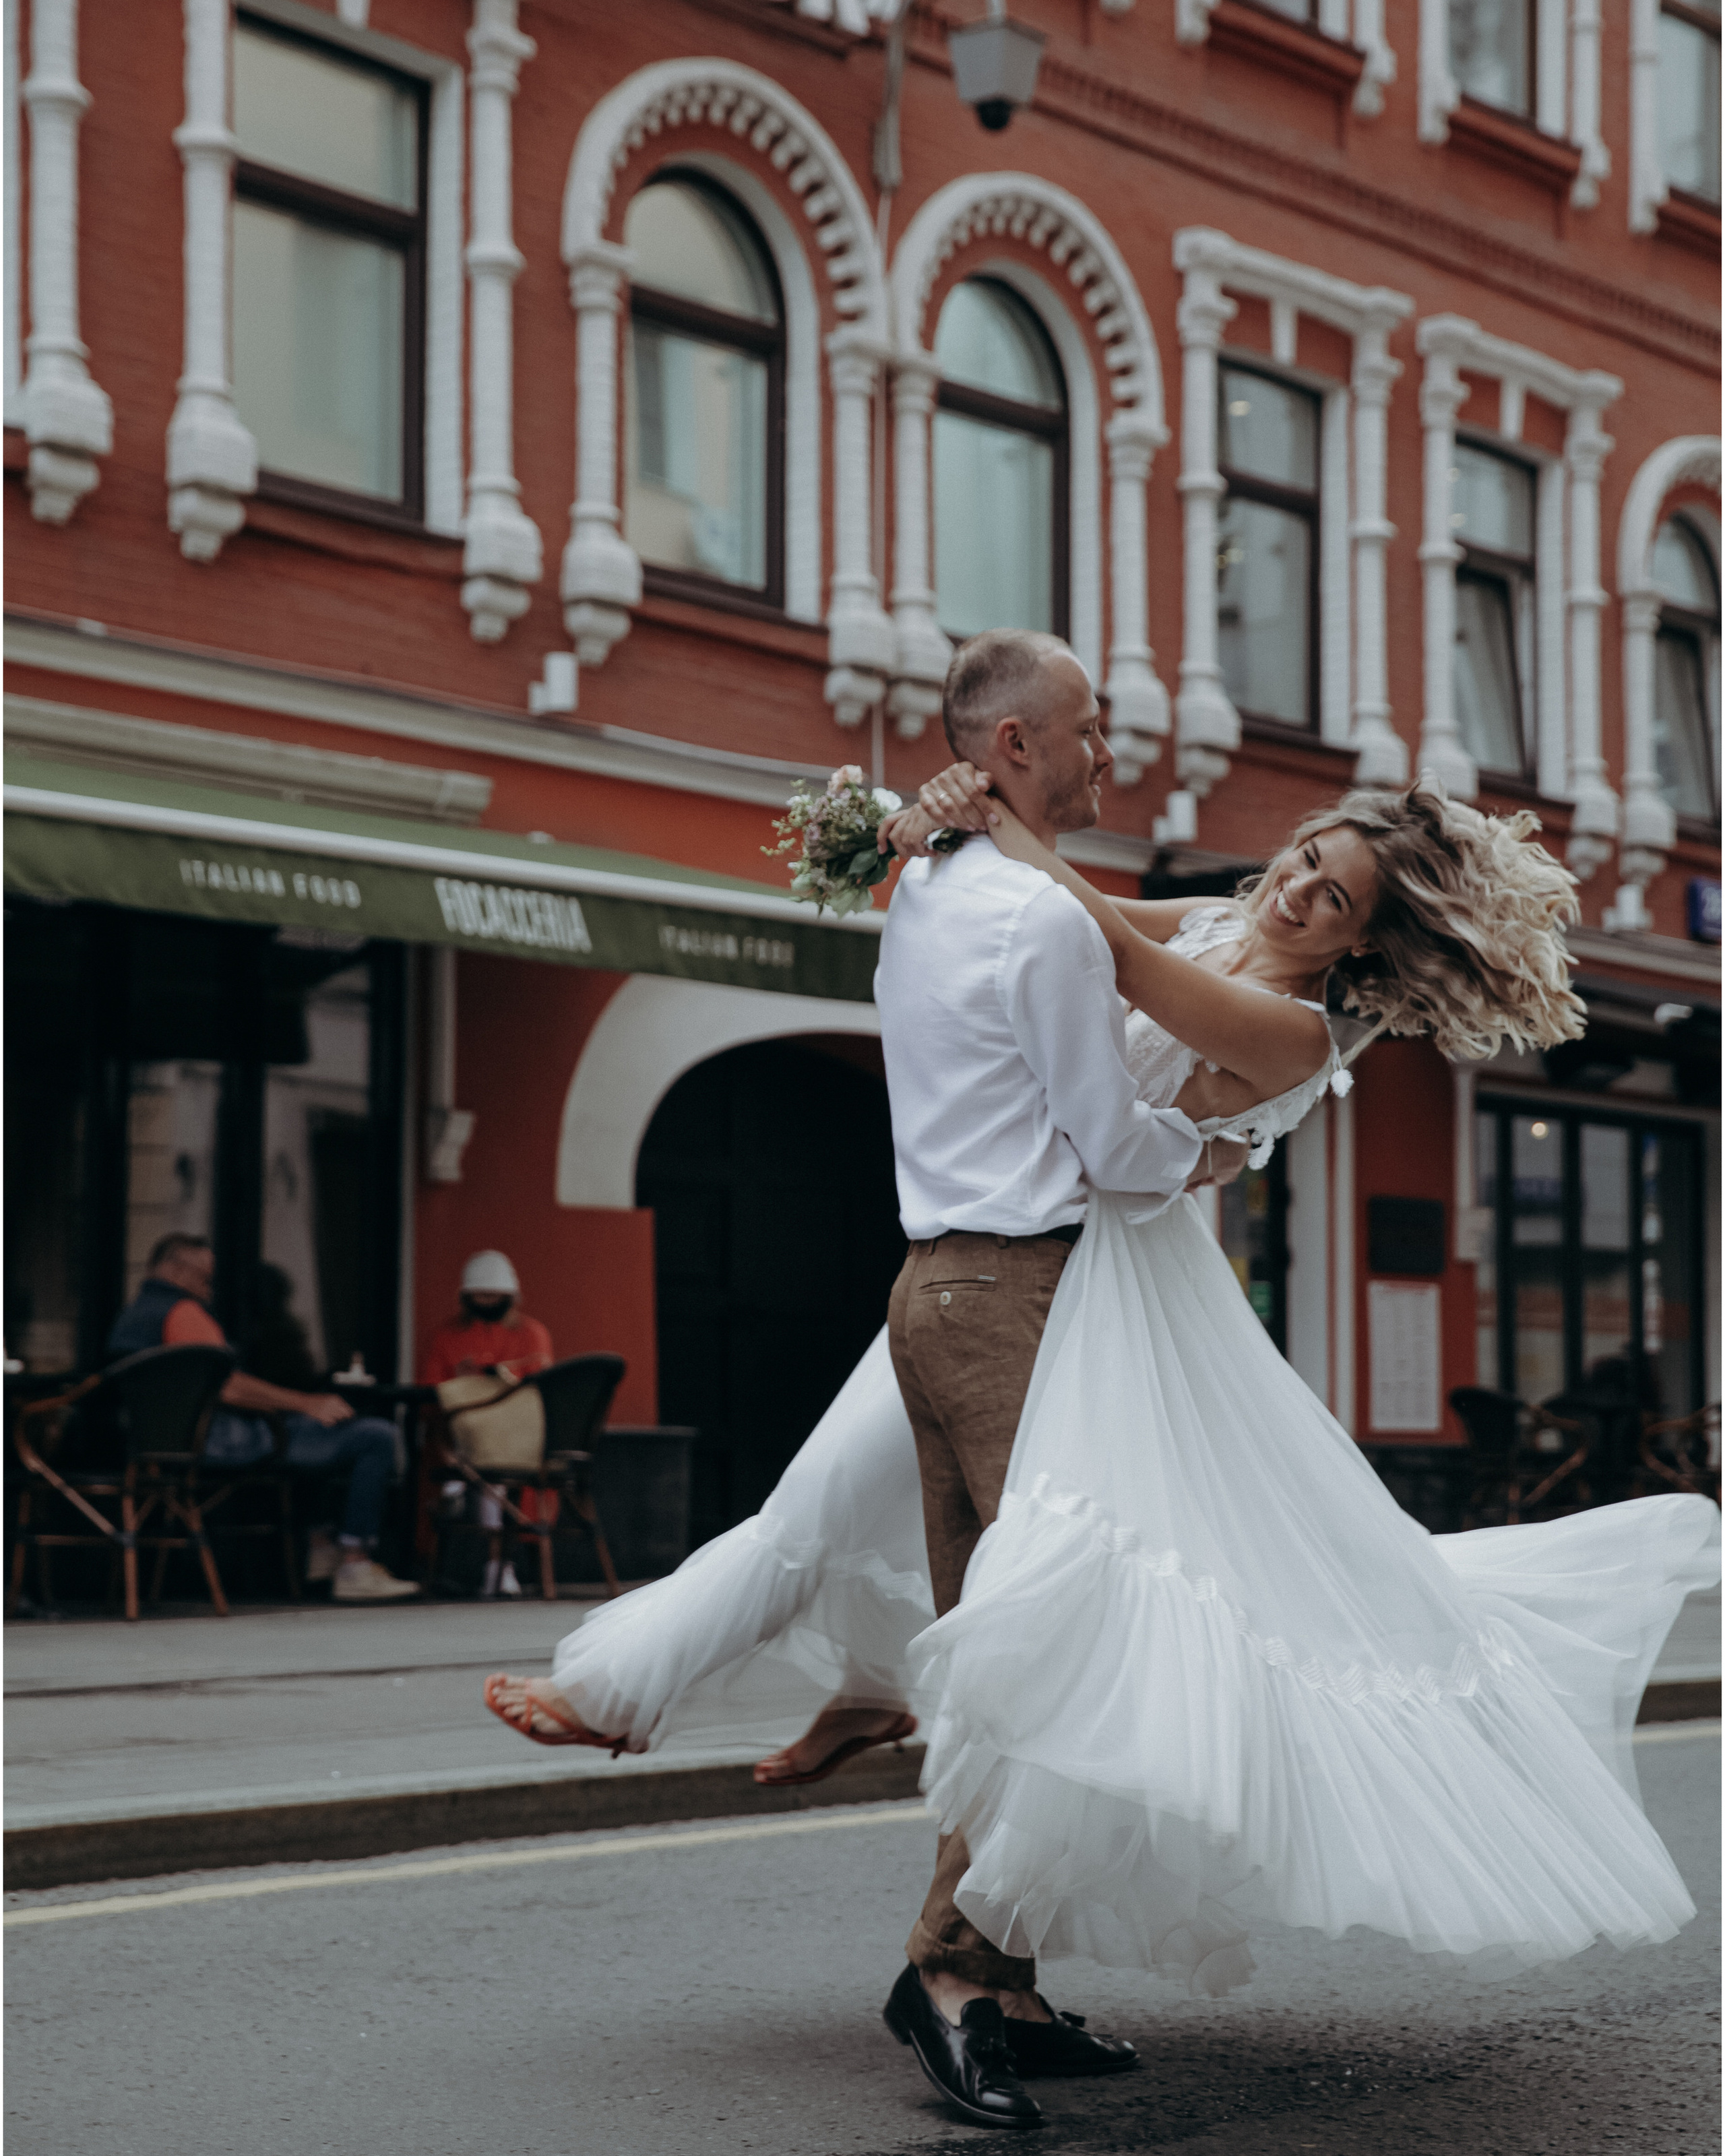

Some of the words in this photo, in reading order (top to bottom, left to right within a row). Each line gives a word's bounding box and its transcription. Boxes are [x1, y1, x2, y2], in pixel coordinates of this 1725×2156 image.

[179, 858, 286, 897] ITALIAN
[292, 873, 362, 908] FOOD
[434, 877, 592, 953] FOCACCERIA
